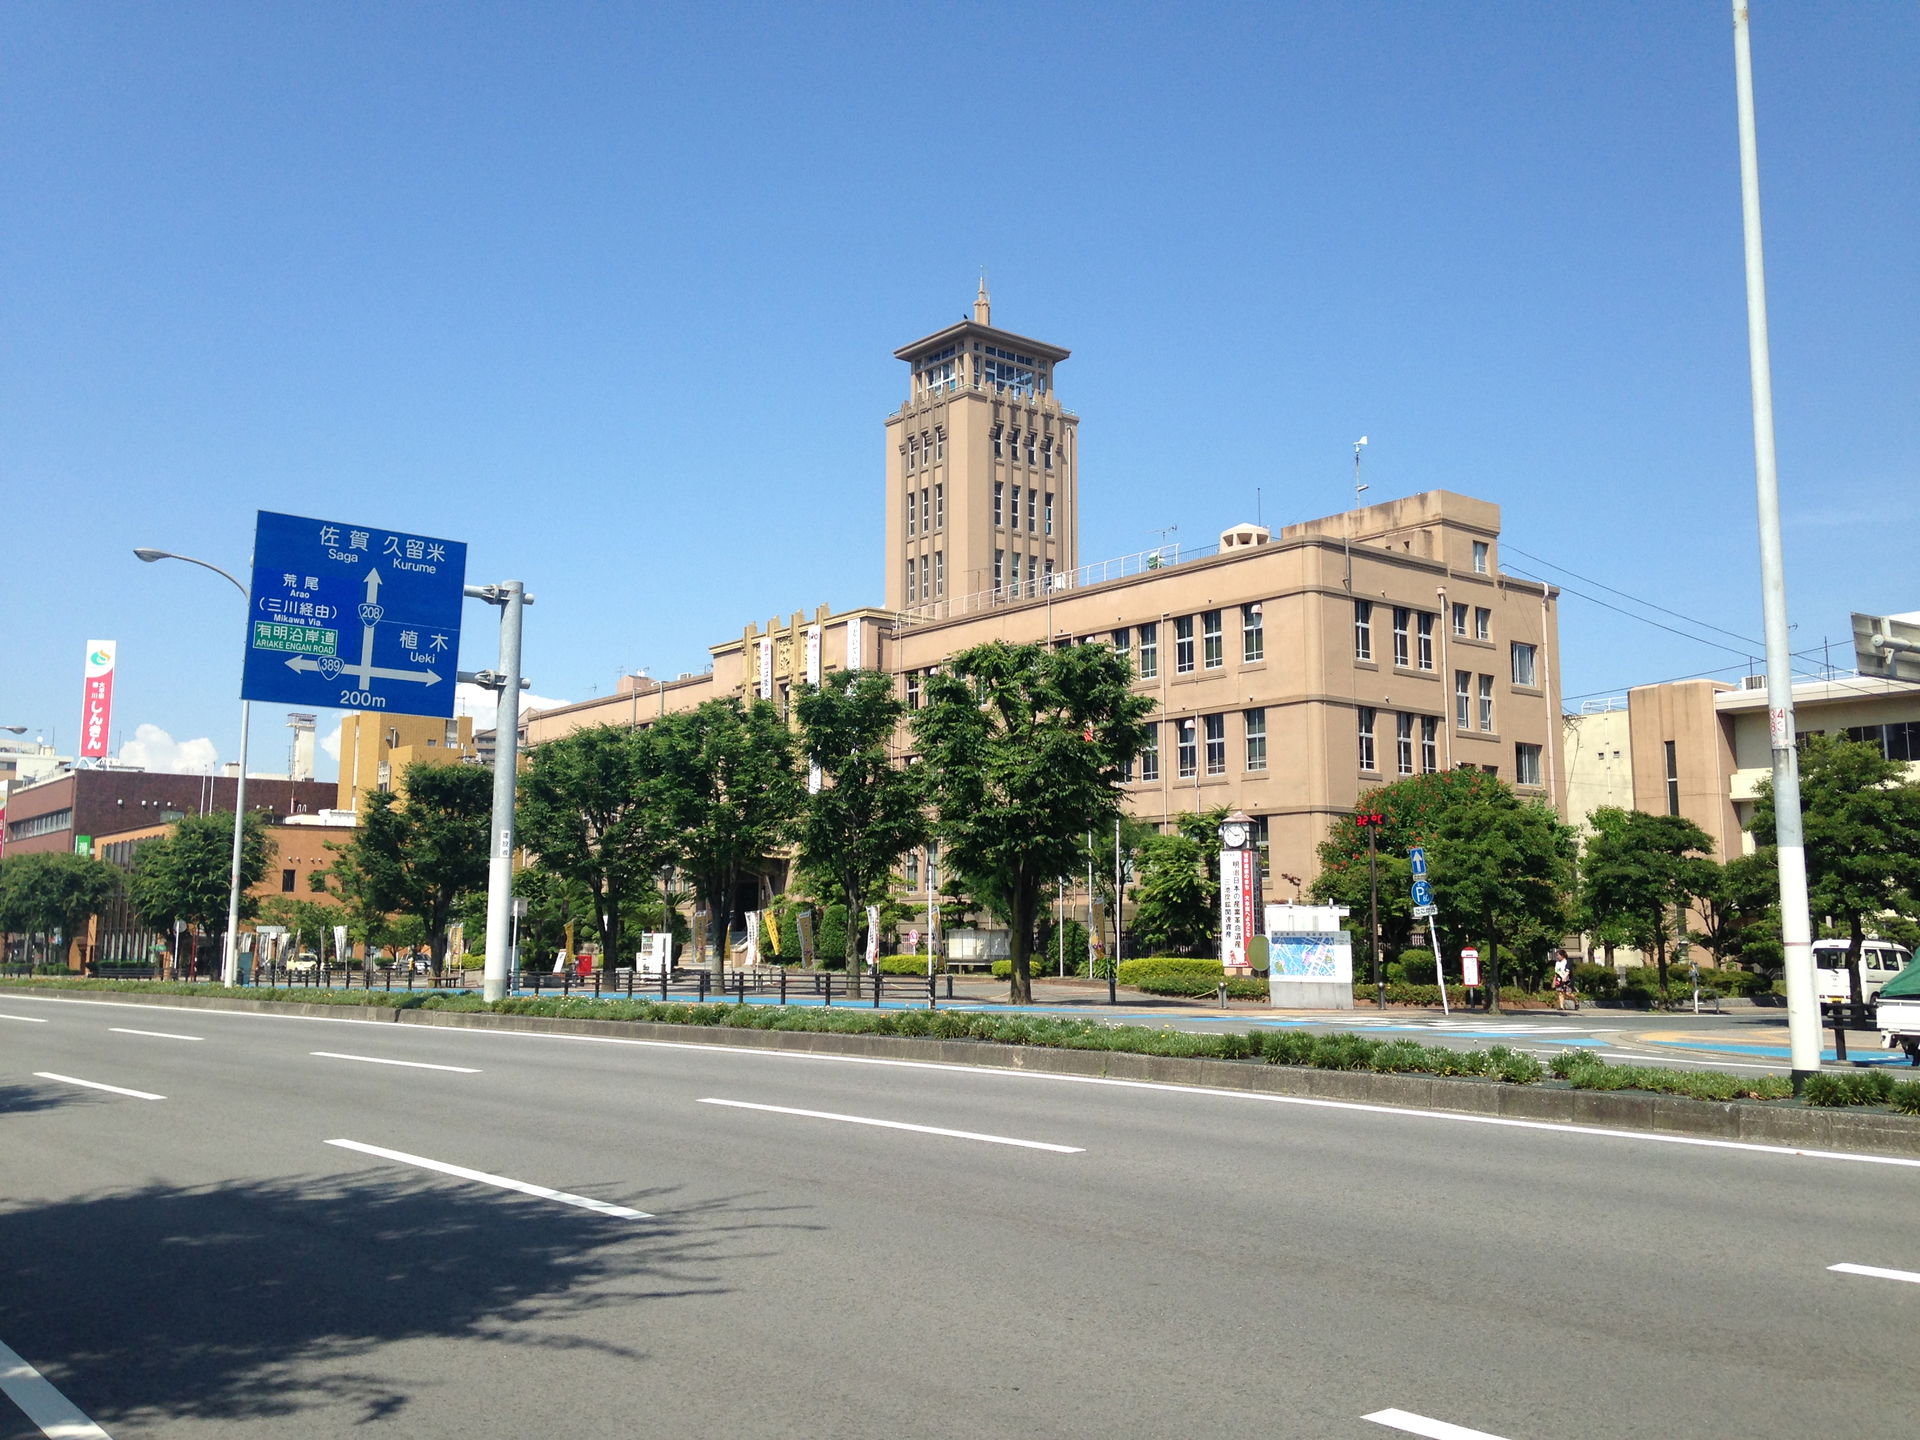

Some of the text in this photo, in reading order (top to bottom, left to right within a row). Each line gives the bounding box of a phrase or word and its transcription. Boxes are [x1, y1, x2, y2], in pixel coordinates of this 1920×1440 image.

[319, 525, 446, 563] 佐賀 久留米
[328, 549, 437, 574] Saga Kurume
[282, 573, 320, 591] 荒尾
[290, 589, 310, 599] Arao
[273, 613, 323, 627] Mikawa Via.
[361, 606, 380, 620] 208
[257, 623, 336, 646] 有明沿岸道
[399, 630, 449, 653] 植木
[256, 639, 334, 655] ARIAKE ENGAN ROAD
[321, 657, 340, 672] 389
[410, 651, 436, 665] Ueki
[339, 689, 386, 708] 200m
[87, 700, 103, 750] しんきん
[1357, 815, 1368, 826] 32
[1416, 886, 1425, 903] P
